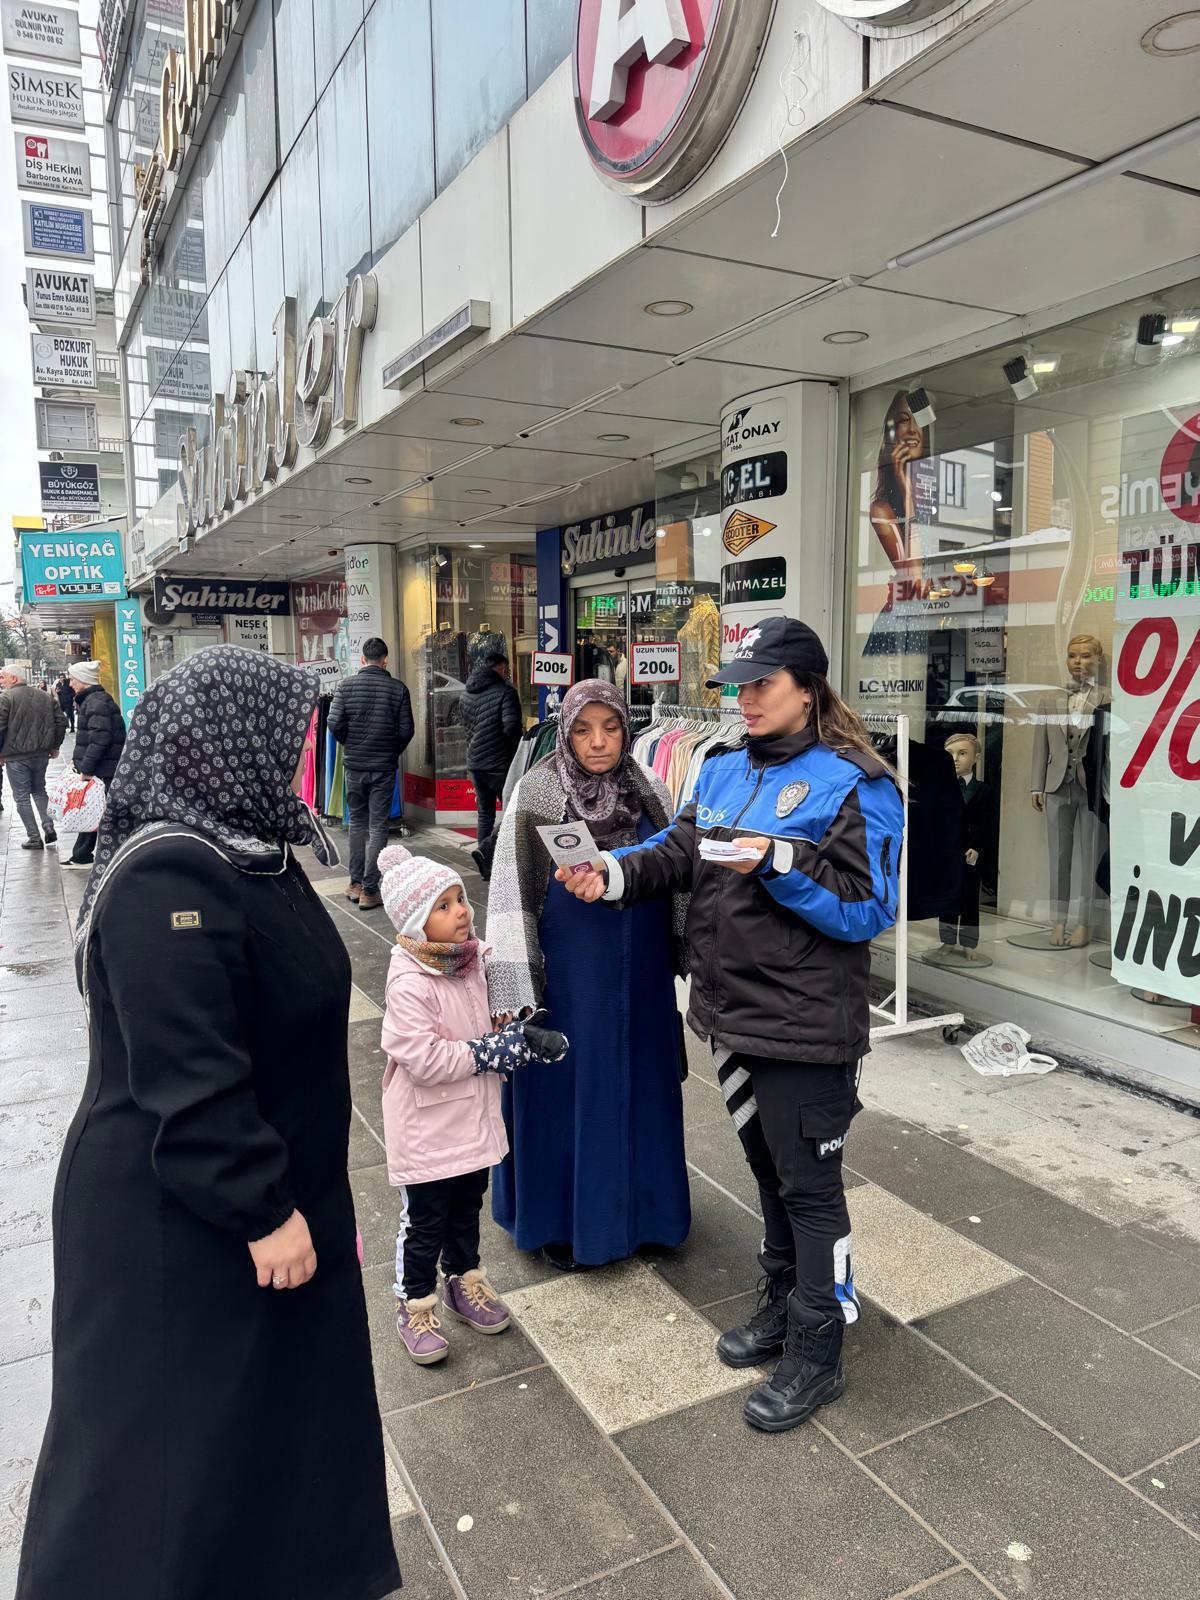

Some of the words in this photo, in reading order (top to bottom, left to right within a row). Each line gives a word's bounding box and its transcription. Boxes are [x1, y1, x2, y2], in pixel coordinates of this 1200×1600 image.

[21, 9, 58, 25] AVUKAT
[43, 24, 64, 36] YAVUZ
[10, 71, 81, 100] ŞİMŞEK
[12, 93, 45, 106] HUKUK
[47, 98, 82, 111] BÜROSU
[25, 159, 43, 171] DİŞ
[46, 163, 82, 176] HEKİMİ
[62, 176, 83, 186] KAYA
[35, 273, 88, 293] AVUKAT
[54, 339, 91, 353] BOZKURT
[60, 355, 88, 368] HUKUK
[46, 366, 63, 376] Kayra
[64, 369, 92, 378] BOZKURT
[742, 420, 781, 440] ONAY
[48, 479, 94, 490] BÜYÜKGÖZ
[725, 523, 760, 541] SCOOTER
[28, 539, 115, 562] YENİÇAĞ
[44, 563, 104, 580] OPTİK
[727, 577, 786, 592] MATMAZEL
[164, 584, 286, 610] Şahinler
[235, 619, 260, 630] NEŞE
[121, 609, 140, 697] YENİÇAĞ
[535, 660, 567, 674] 200₺
[638, 661, 675, 674] 200₺
[859, 680, 879, 693] LC
